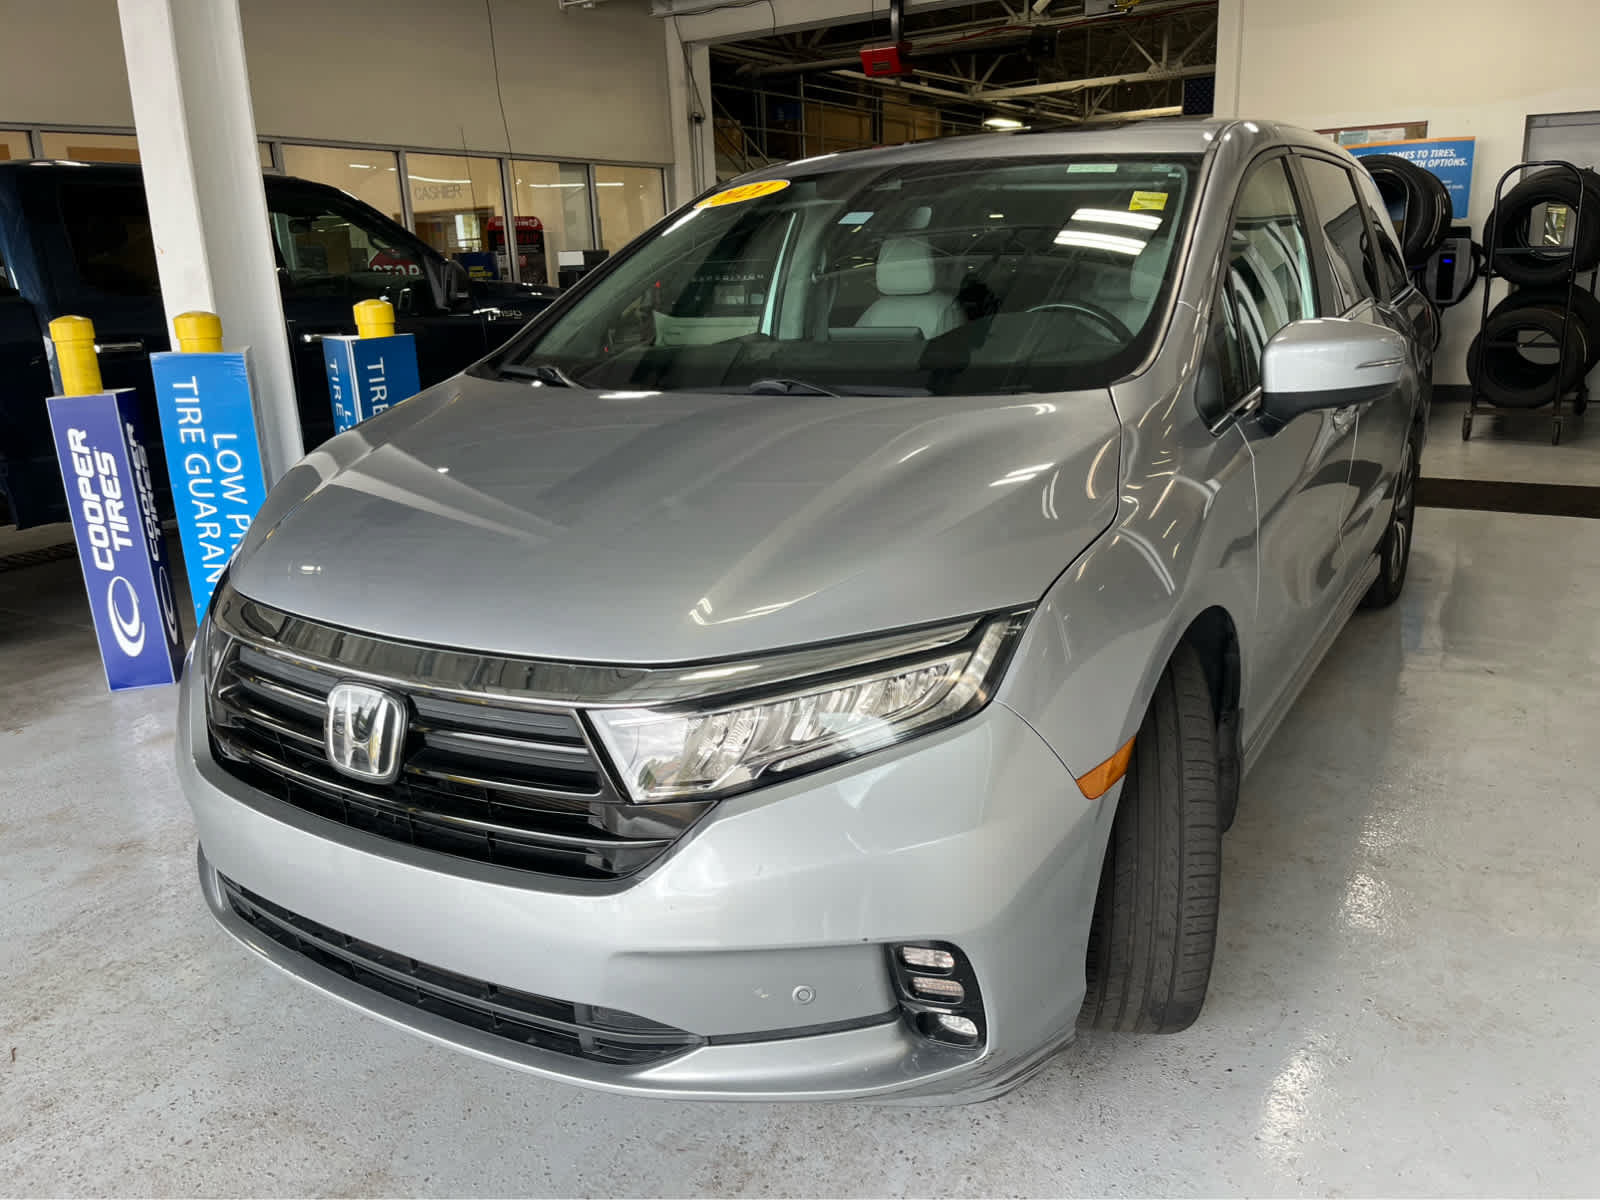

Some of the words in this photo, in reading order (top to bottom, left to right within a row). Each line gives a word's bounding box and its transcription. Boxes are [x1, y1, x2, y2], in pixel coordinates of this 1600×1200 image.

[1417, 149, 1428, 159] TO
[172, 376, 207, 444] TIRE
[329, 357, 345, 417] TIRE
[67, 428, 115, 571] COOPER
[94, 448, 133, 551] TIRES
[213, 433, 248, 505] LOW
[184, 453, 226, 595] GUARAN
